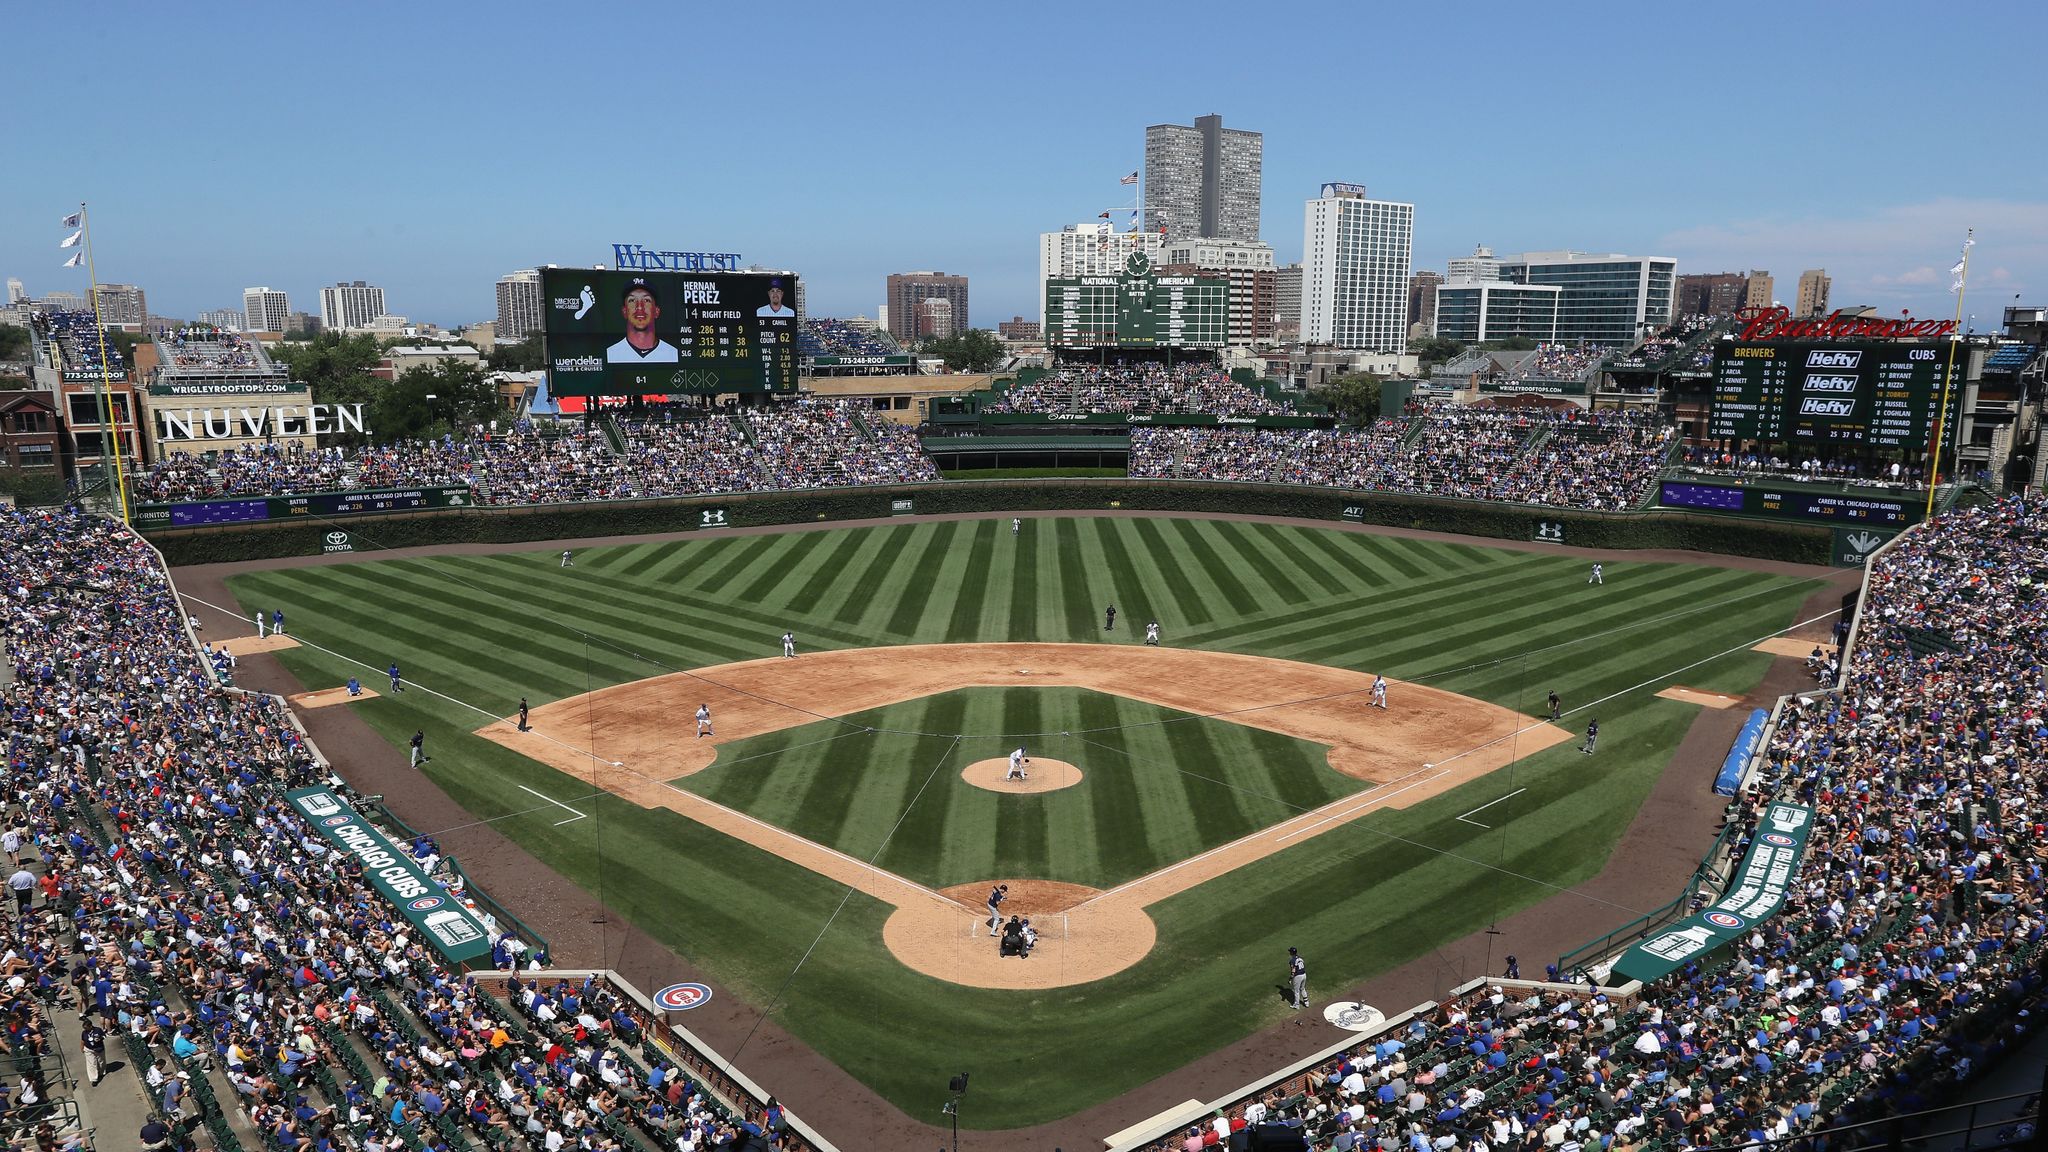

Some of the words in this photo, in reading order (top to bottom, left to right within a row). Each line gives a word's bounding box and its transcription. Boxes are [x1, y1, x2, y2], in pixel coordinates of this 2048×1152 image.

[612, 243, 741, 272] WINTRUST
[684, 281, 716, 290] HERNAN
[1082, 277, 1118, 286] NATIONAL
[1157, 277, 1194, 286] AMERICAN
[684, 290, 720, 304] PEREZ
[702, 310, 722, 319] RIGHT
[724, 311, 742, 319] FIELD
[1735, 306, 1963, 341] Budweiser
[698, 325, 714, 334] .286
[738, 325, 743, 334] 9
[699, 337, 715, 346] .313
[737, 337, 746, 346] 38
[780, 333, 790, 343] 62
[700, 349, 716, 358] .448
[736, 349, 748, 358] 241
[1734, 348, 1775, 358] BREWERS
[1909, 350, 1936, 360] CUBS
[556, 356, 598, 365] wendella
[1810, 353, 1857, 368] Hefty
[64, 371, 124, 379] 773-248-ROOF
[172, 383, 286, 394] WRIGLEYROOFTOPS.COM
[1806, 376, 1854, 391] Hefty
[1803, 400, 1850, 415] Hefty
[163, 404, 365, 440] NUVEEN
[1134, 414, 1152, 422] pepsi
[1217, 414, 1257, 424] Budweiser
[1343, 506, 1364, 515] ATI
[1880, 503, 1901, 511] GAMES)
[1774, 847, 1794, 864] FIELD
[334, 825, 397, 870] CHICAGO
[379, 866, 429, 899] CUBS
[1716, 884, 1759, 911] WELCOME
[1750, 844, 1774, 868] FRIENDLY
[1767, 860, 1790, 885] WRIGLEY
[1739, 892, 1781, 919] CONFINES
